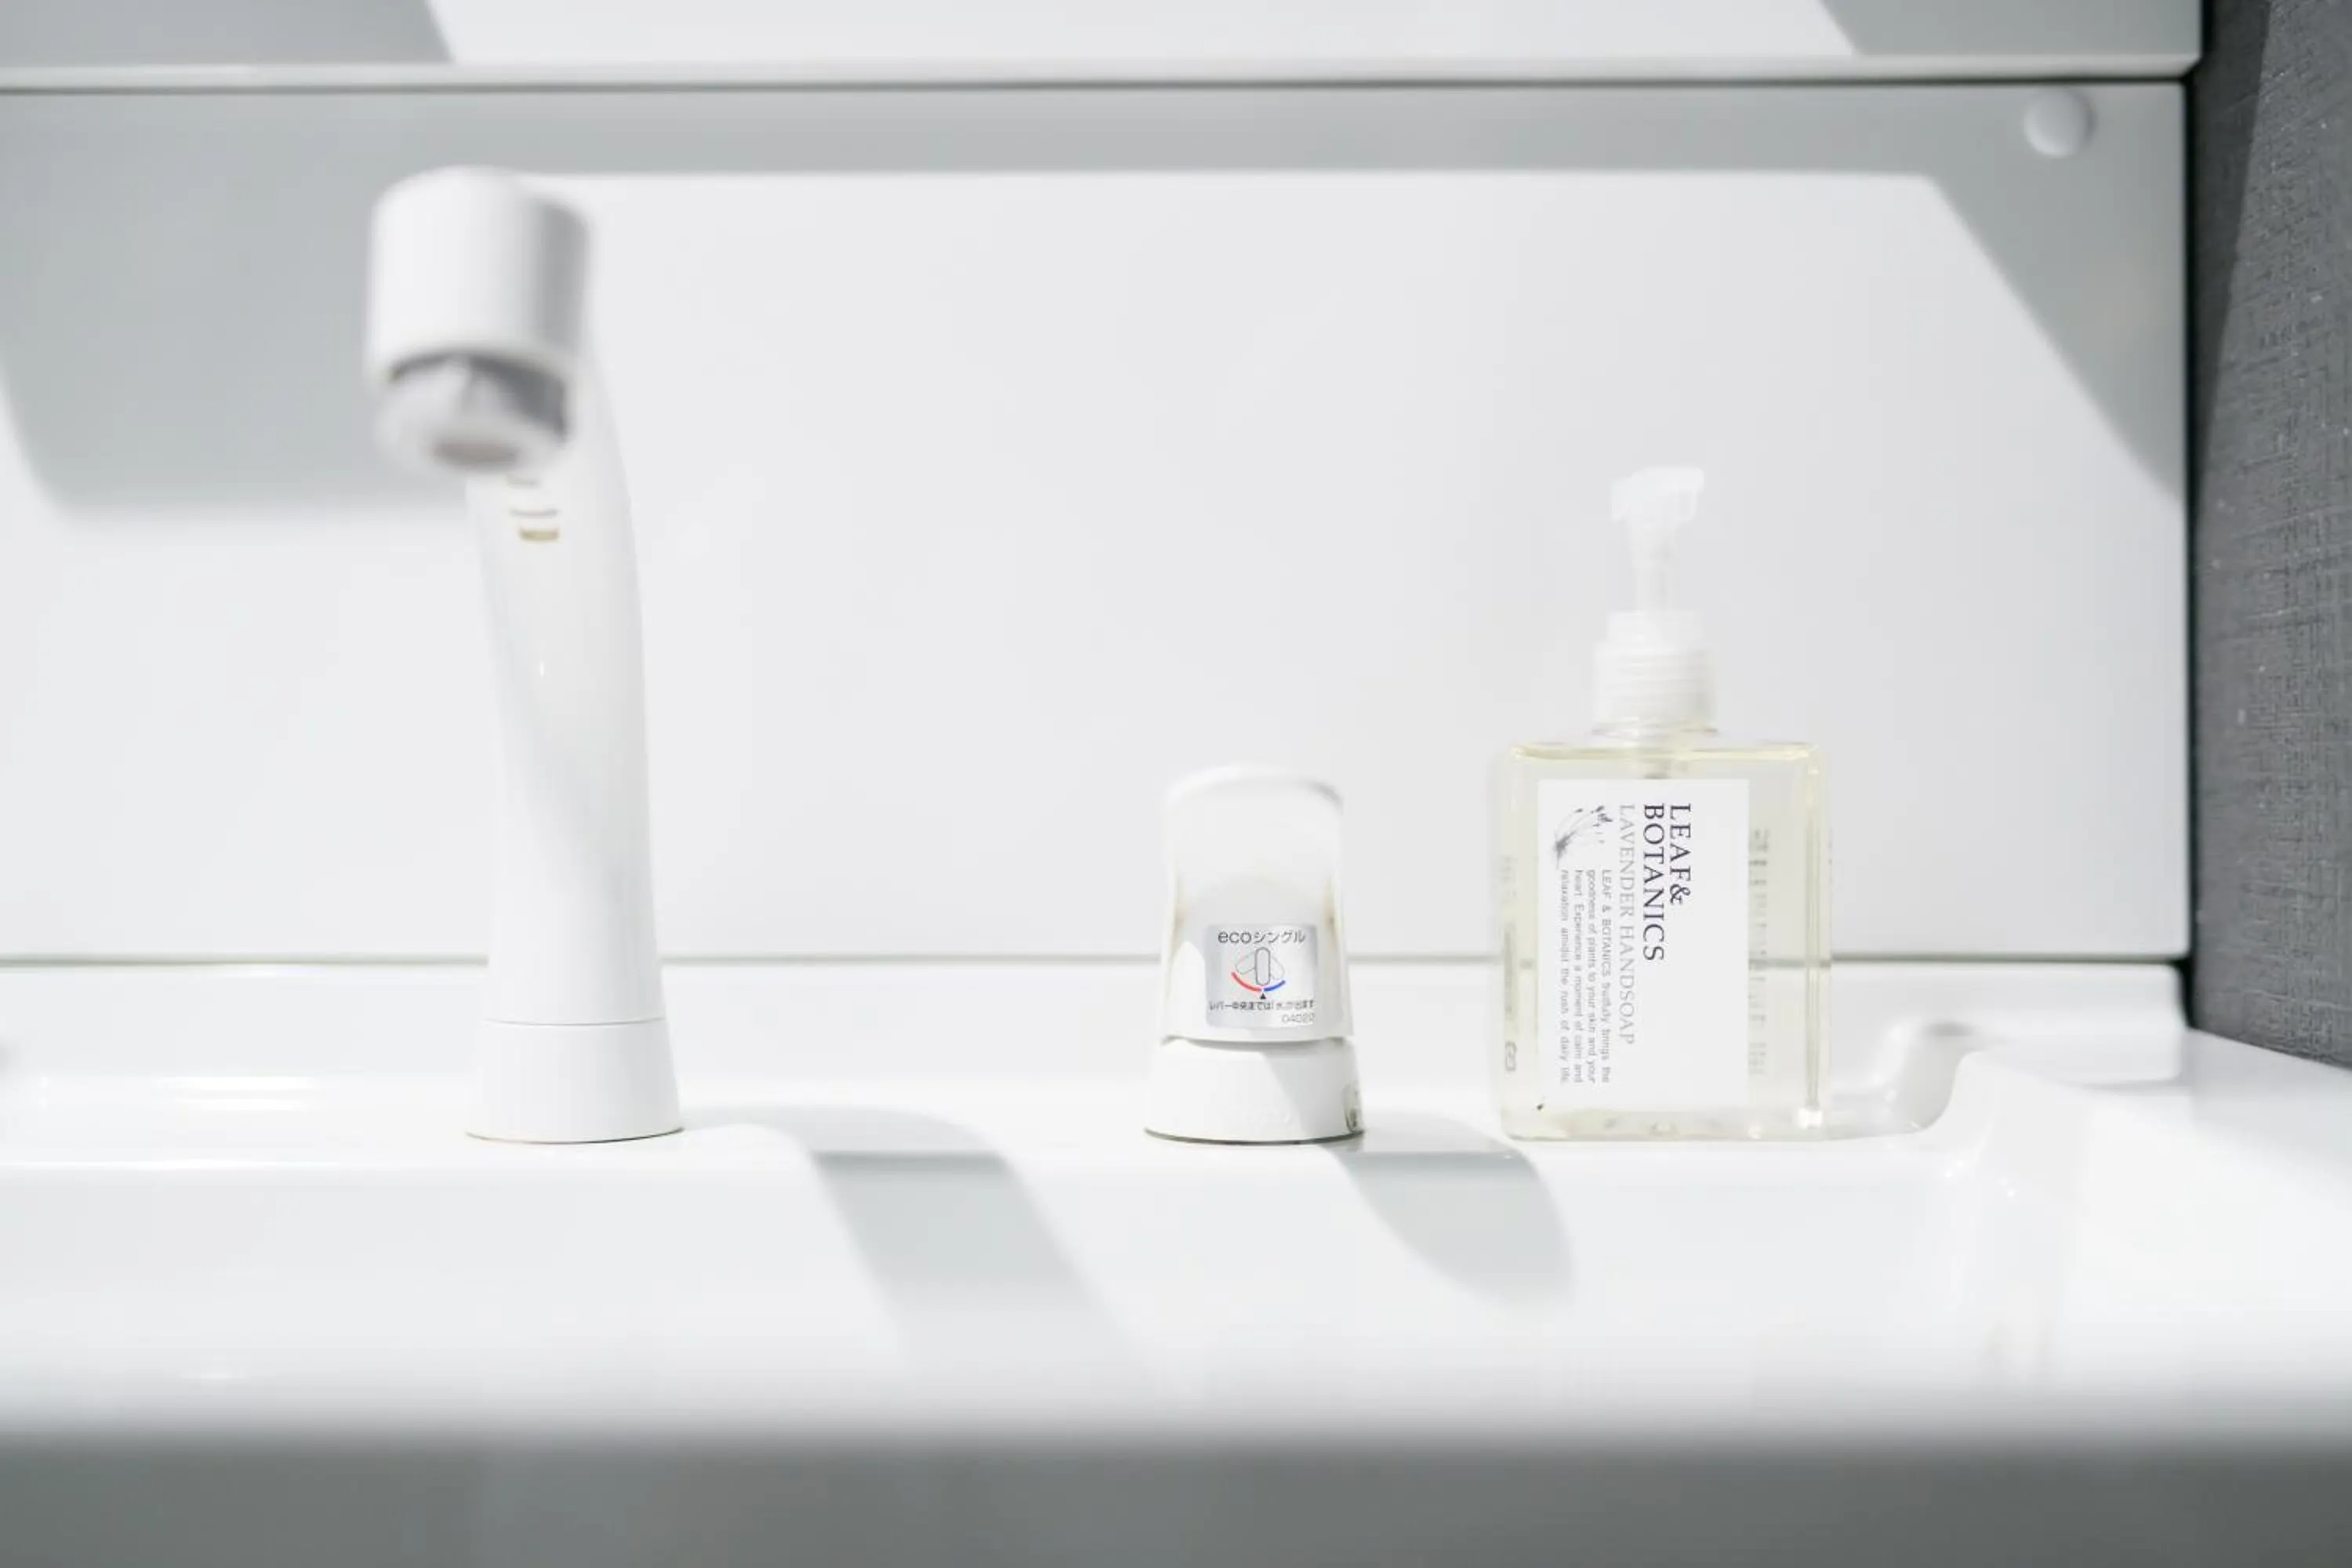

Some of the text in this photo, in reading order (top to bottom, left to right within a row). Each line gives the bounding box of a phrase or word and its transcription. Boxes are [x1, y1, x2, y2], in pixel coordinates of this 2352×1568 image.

[1670, 803, 1691, 905] LEAF&
[1560, 869, 1570, 921] relaxation
[1602, 869, 1612, 899] LEAF
[1643, 803, 1664, 960] BOTANICS
[1218, 931, 1305, 944] ecoシングル
[1573, 903, 1584, 960] Experience
[1618, 804, 1635, 1044] LAVENDER HANDSOAP
[1601, 918, 1613, 978] BOTANICS
[1560, 968, 1571, 985] the
[1585, 869, 1599, 1083] goodness of plants to your skin and your
[1559, 990, 1570, 1014] rush
[1573, 976, 1585, 1017] moment
[1560, 1020, 1570, 1031] of
[1573, 1021, 1585, 1031] of
[1559, 1036, 1570, 1062] daily
[1574, 1035, 1584, 1059] calm
[1599, 1029, 1611, 1061] brings
[1573, 1064, 1584, 1083] and
[1602, 1066, 1611, 1083] the
